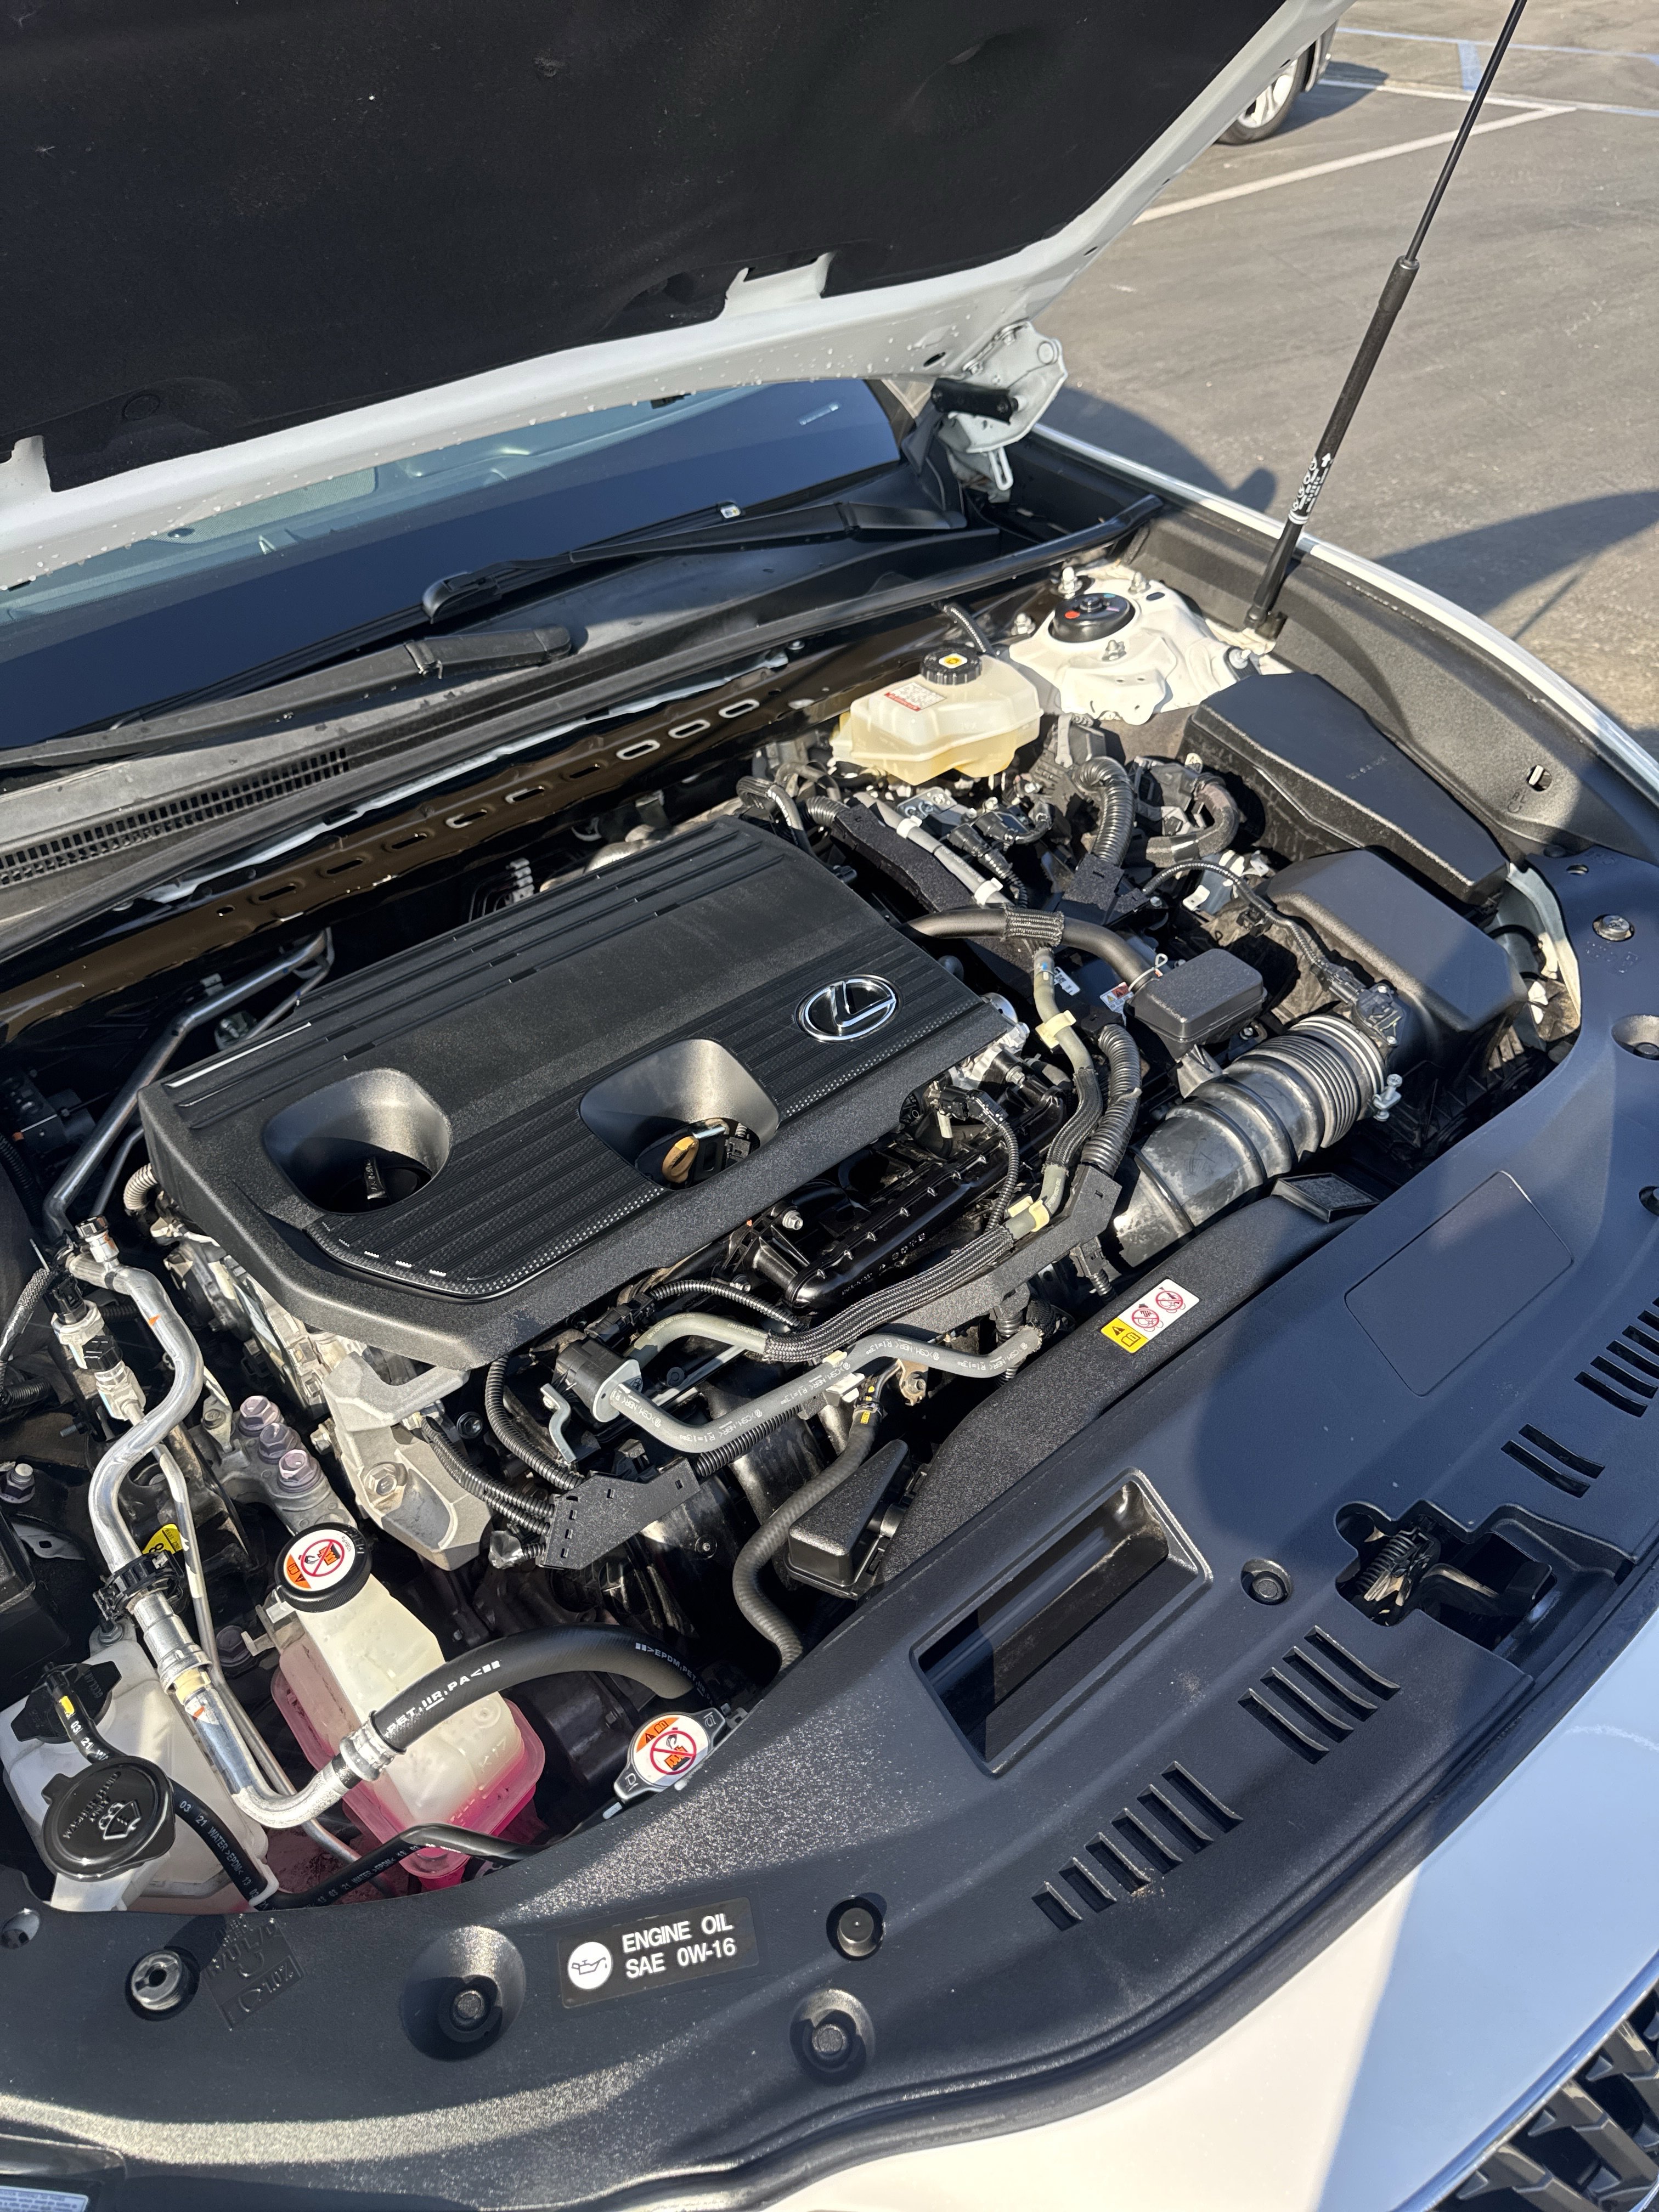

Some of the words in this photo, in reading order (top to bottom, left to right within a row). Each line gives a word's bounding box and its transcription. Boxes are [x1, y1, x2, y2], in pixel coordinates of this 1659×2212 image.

[179, 1800, 191, 1813] 03
[195, 1815, 208, 1827] 21
[207, 1826, 229, 1852] WATER
[241, 1876, 252, 1887] 13
[351, 1870, 373, 1884] WATER
[622, 1921, 692, 1954] ENGINE
[701, 1913, 734, 1935] OIL
[625, 1952, 667, 1979] SAE
[677, 1937, 737, 1966] 0W-16
